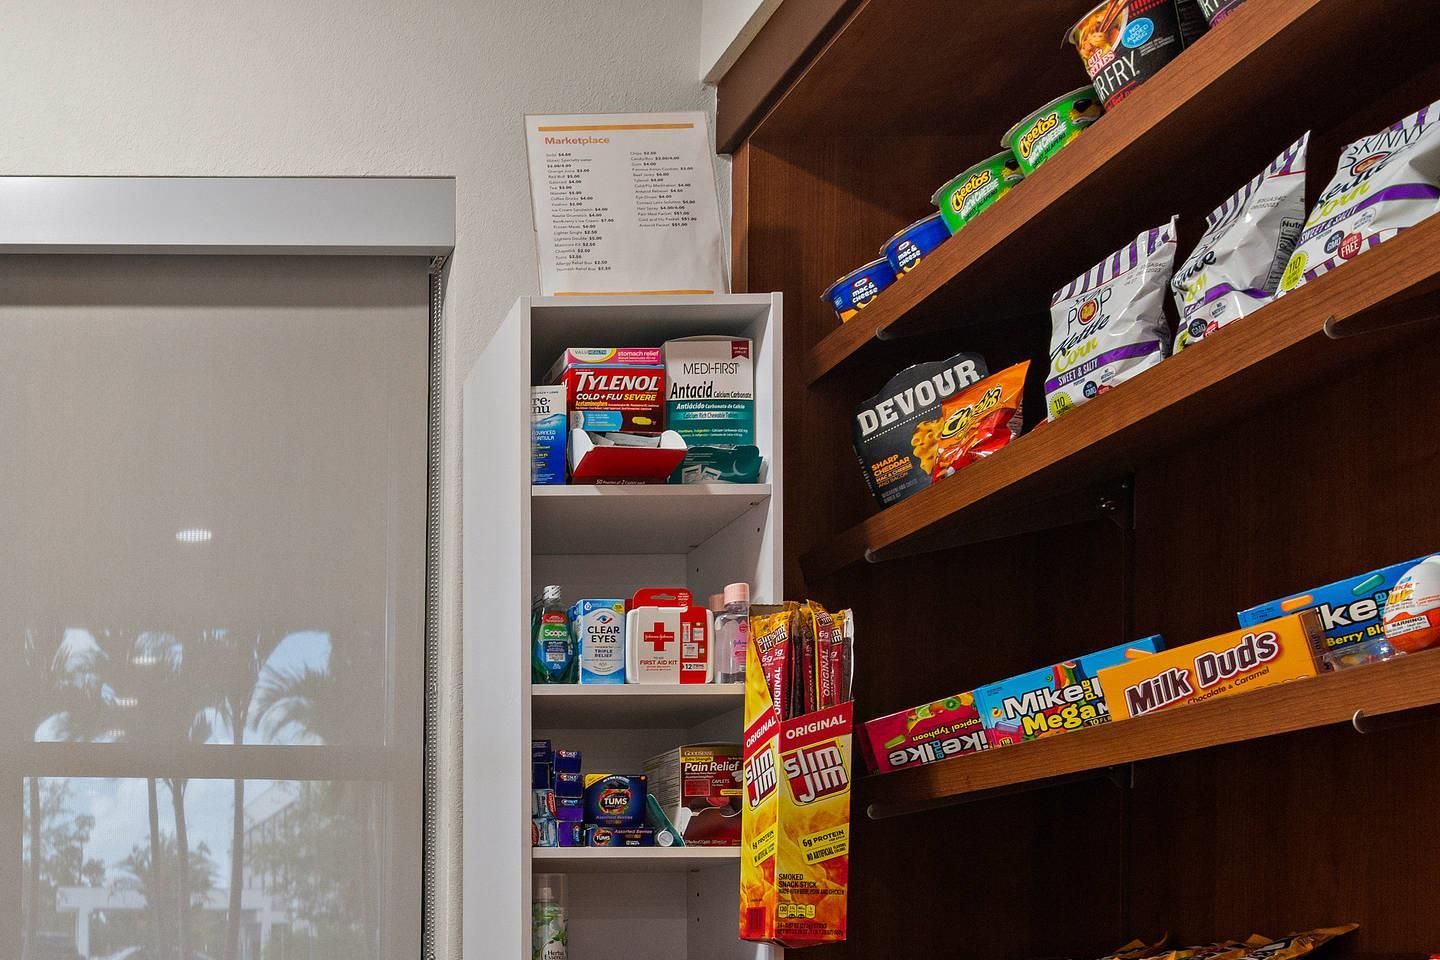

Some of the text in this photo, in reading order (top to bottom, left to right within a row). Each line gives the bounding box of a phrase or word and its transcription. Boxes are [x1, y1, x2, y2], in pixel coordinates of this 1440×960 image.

[1104, 51, 1137, 93] FRY
[544, 136, 609, 146] Marketplace
[1019, 113, 1058, 159] Cheetos
[1349, 121, 1434, 156] SKINNY
[951, 170, 992, 212] Cheetos
[1340, 240, 1360, 258] FREE
[683, 362, 739, 375] MEDI-FIRST
[1058, 370, 1077, 386] SWEET
[575, 371, 660, 393] TYLENOL
[670, 380, 752, 399] Antacid Calcium Carbonate
[576, 393, 600, 401] COLD
[606, 393, 624, 401] FLU
[623, 393, 657, 401] SEVERE
[871, 454, 900, 471] SHARP
[873, 456, 910, 477] CHEDDAR
[544, 628, 568, 638] Scope
[587, 625, 621, 634] CLEAR
[591, 635, 617, 643] EYES
[1326, 629, 1364, 649] Berry
[1124, 630, 1279, 719] Milk Duds
[1234, 665, 1271, 687] Caramel
[1003, 684, 1084, 720] Mike
[785, 714, 847, 741] ORIGINAL
[1022, 703, 1097, 736] Mega
[746, 716, 777, 748] ORIGINAL
[912, 725, 950, 742] Typhoon
[941, 731, 991, 753] ike
[684, 760, 740, 772] Pain Relief
[746, 742, 774, 783] slim
[783, 746, 845, 779] slim
[603, 796, 629, 806] TUMS
[595, 834, 611, 842] TUMS
[802, 839, 813, 848] 6g
[813, 829, 845, 844] PROTEIN
[778, 873, 804, 881] SMOKED
[778, 880, 817, 888] SNACK STICK
